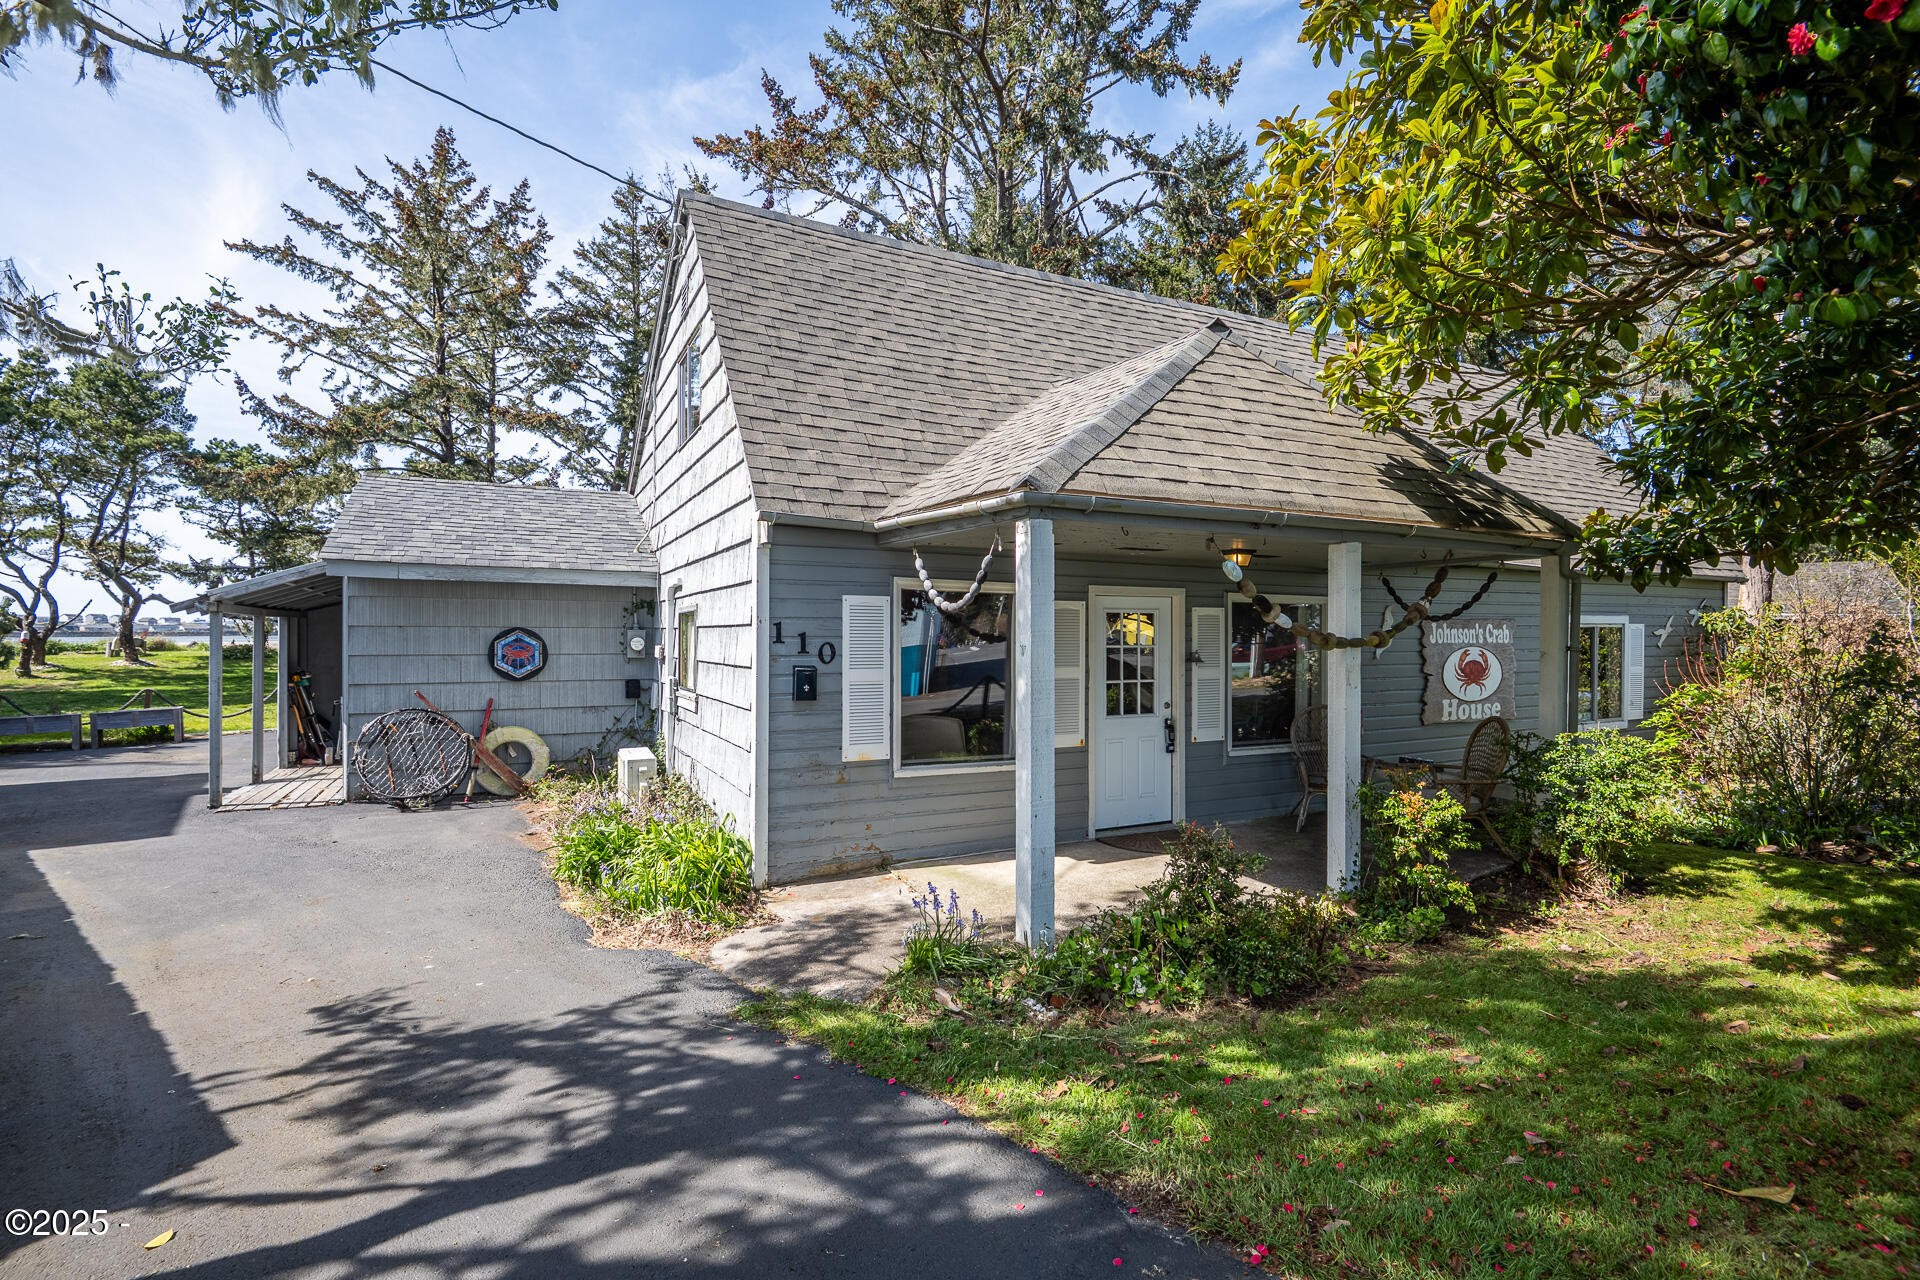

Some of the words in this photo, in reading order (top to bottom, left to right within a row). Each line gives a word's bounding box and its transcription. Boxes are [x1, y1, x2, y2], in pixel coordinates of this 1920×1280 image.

[773, 621, 836, 664] 110
[1429, 622, 1484, 644] Johnson's
[1485, 623, 1510, 643] Crab
[1442, 699, 1501, 720] House
